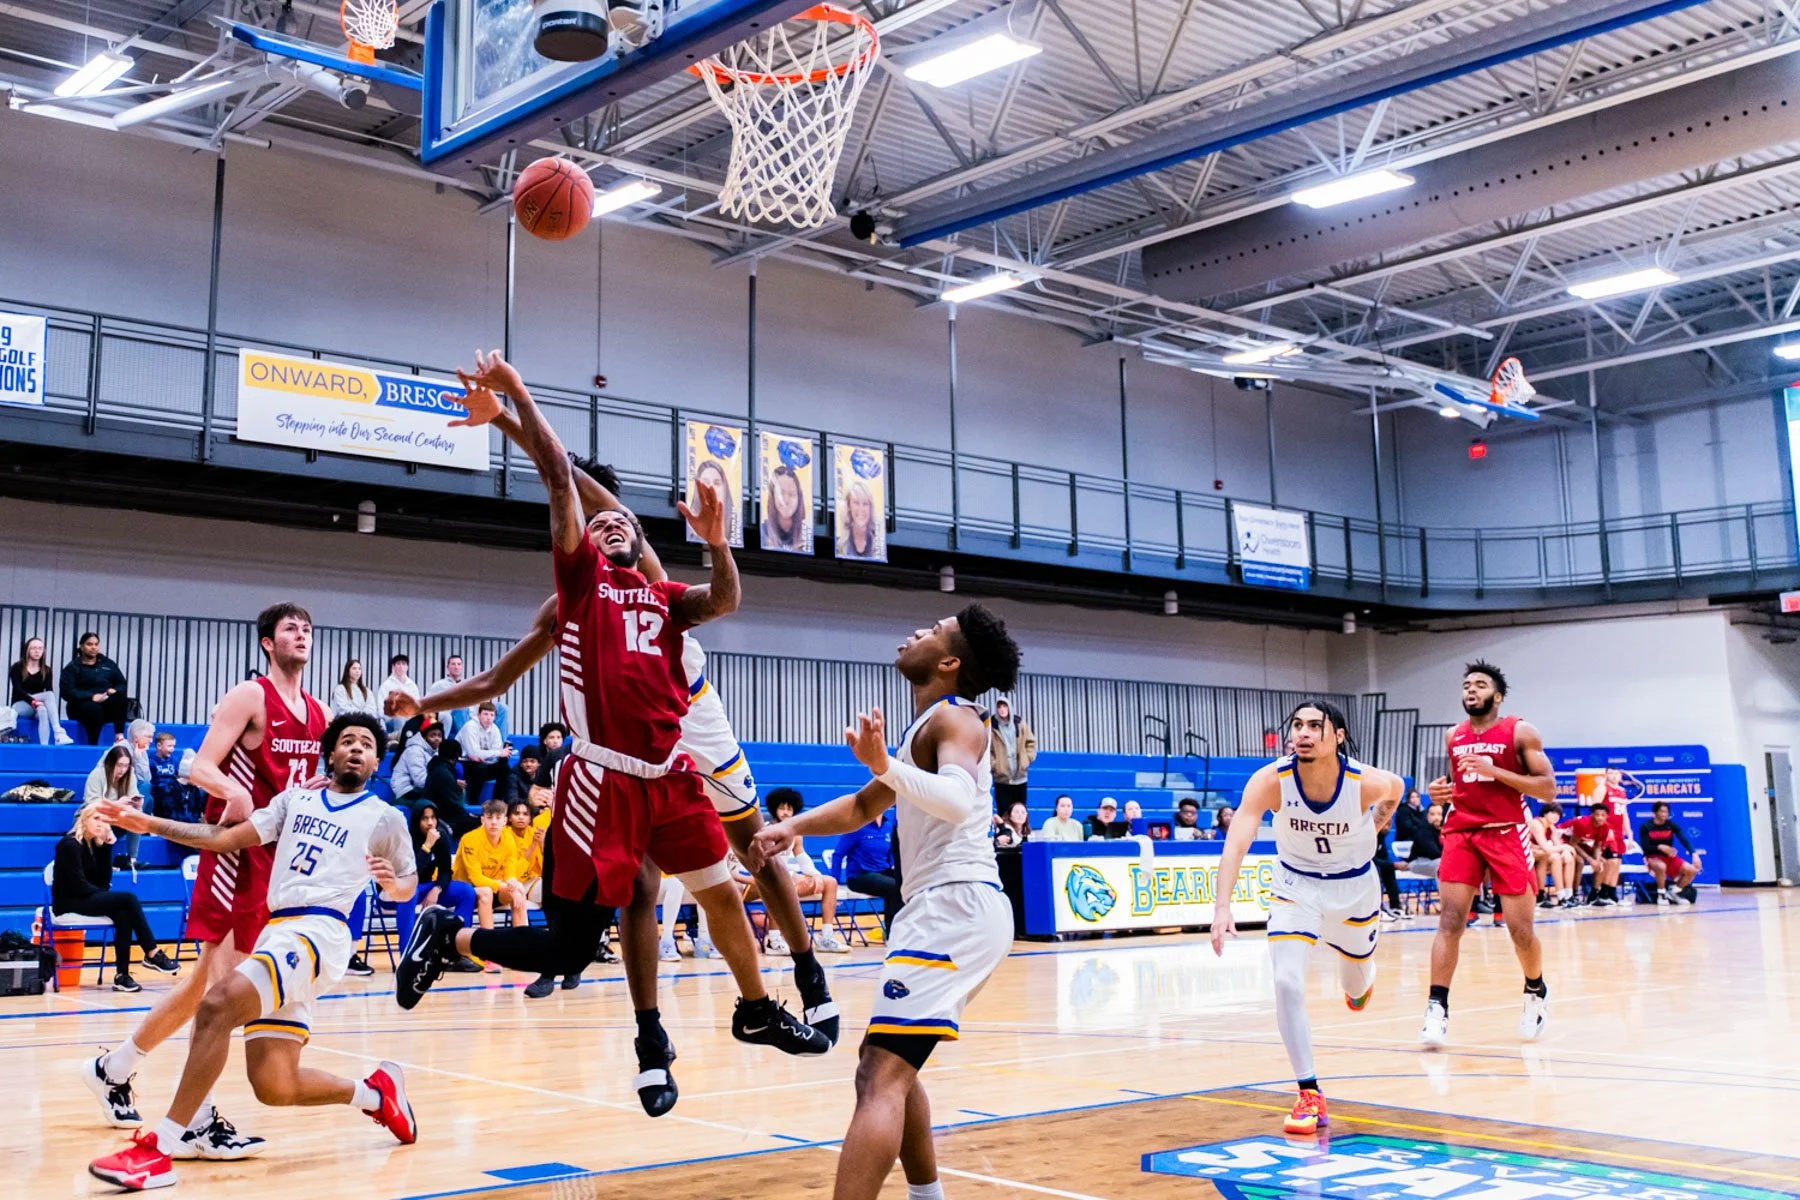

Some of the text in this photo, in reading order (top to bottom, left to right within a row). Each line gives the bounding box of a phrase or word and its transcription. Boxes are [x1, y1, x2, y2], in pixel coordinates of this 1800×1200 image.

[0, 348, 36, 366] GOLF
[251, 362, 468, 413] ONWARD, BRESCI
[276, 413, 455, 455] Stepping into Our Second Century
[622, 609, 664, 656] 12
[1452, 742, 1507, 757] SOUTHEAST
[292, 814, 349, 848] BRESCIA
[1290, 818, 1350, 835] BRESCIA
[289, 841, 323, 877] 25
